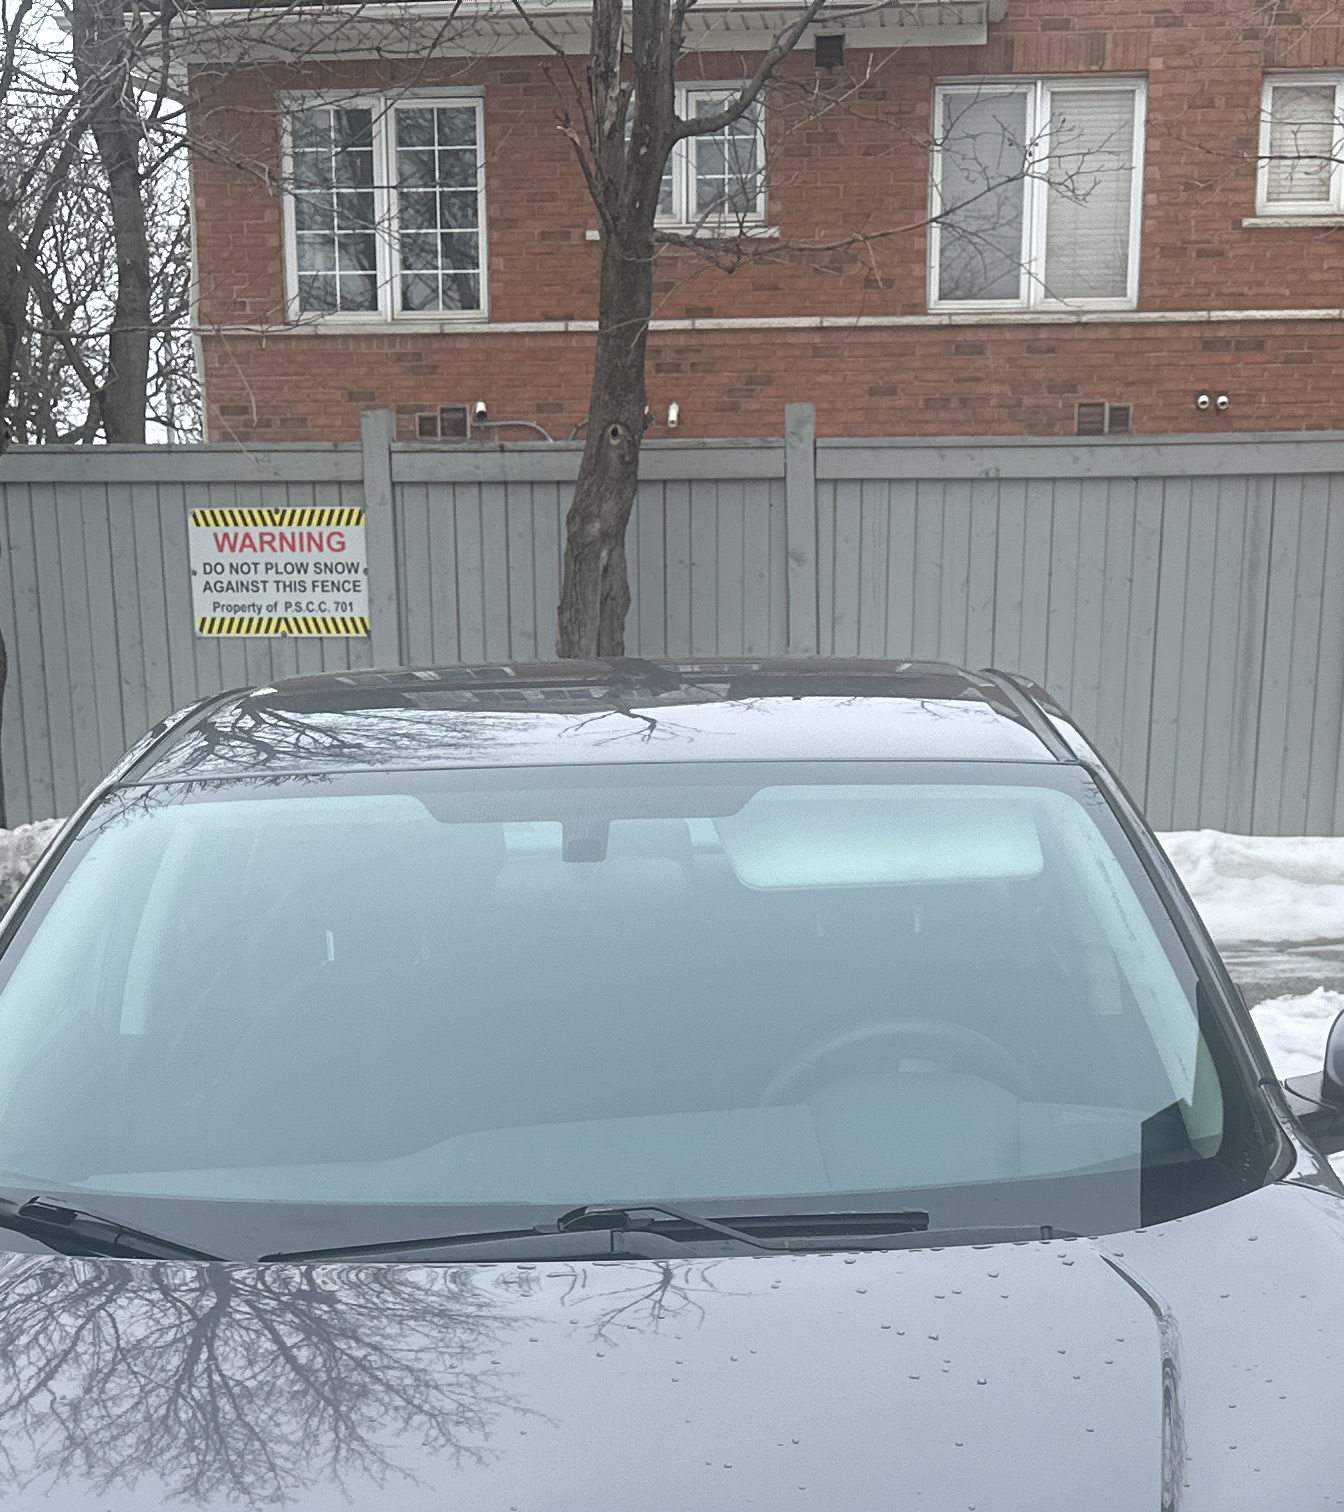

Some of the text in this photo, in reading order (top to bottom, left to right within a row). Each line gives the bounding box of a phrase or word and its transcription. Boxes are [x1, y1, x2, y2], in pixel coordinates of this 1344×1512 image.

[212, 530, 347, 553] WARNING
[203, 562, 360, 575] DO NOT PLOW SNOW
[202, 580, 362, 593] AGAINST THIS FENCE
[212, 601, 354, 616] Property of P.S.C.C. 701
